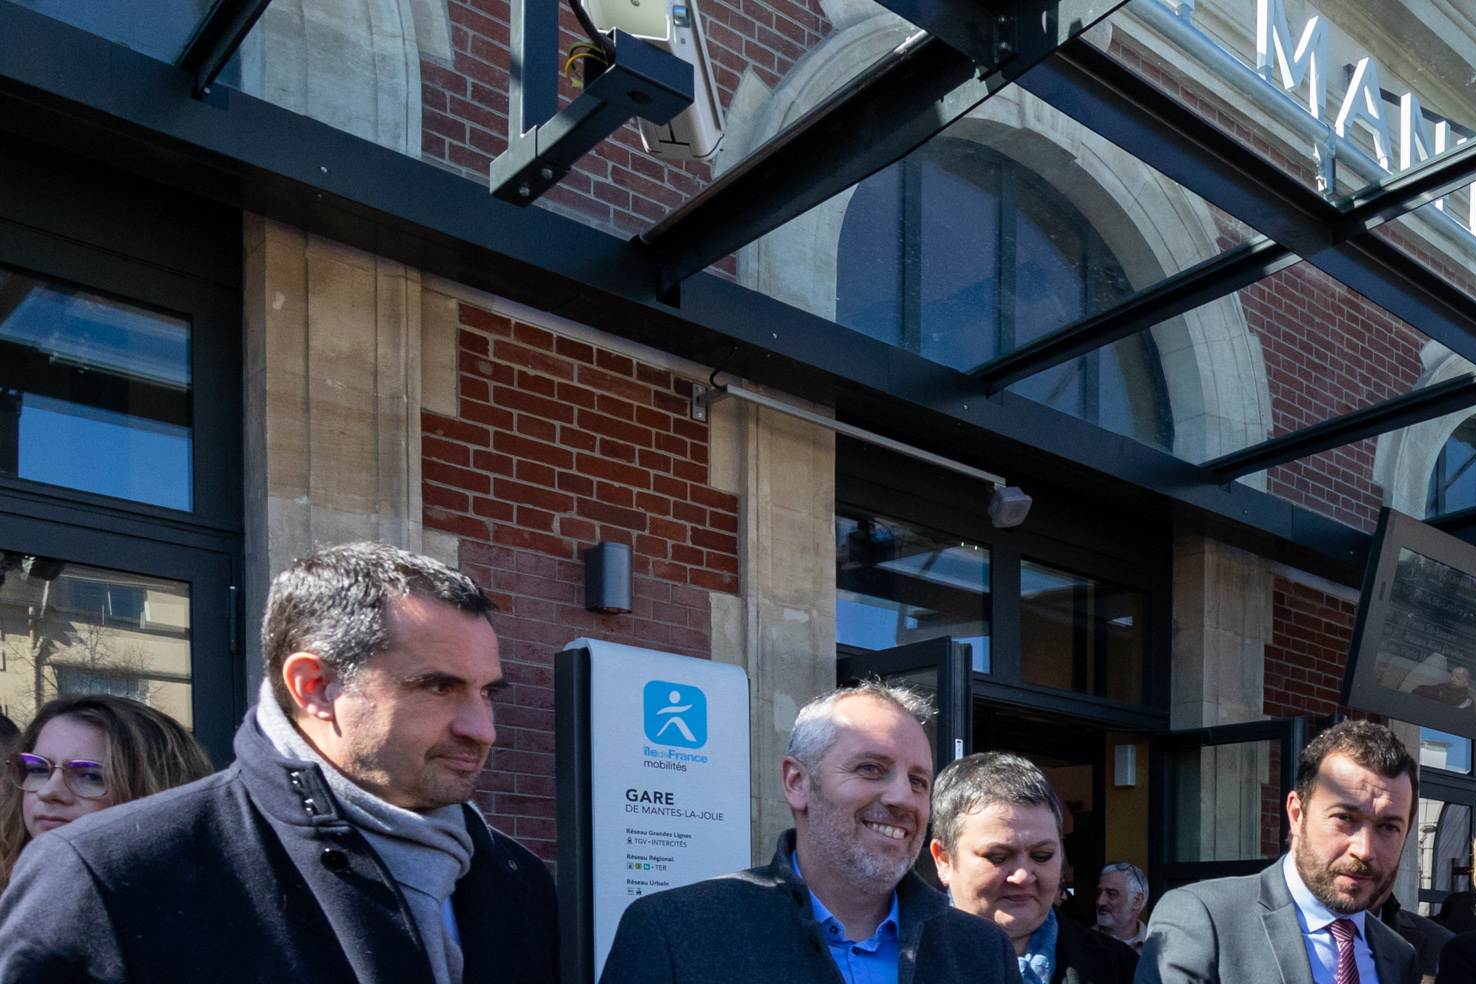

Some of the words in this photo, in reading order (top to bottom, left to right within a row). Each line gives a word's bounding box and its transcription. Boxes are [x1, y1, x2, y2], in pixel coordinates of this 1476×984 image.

[643, 760, 687, 772] mobilités
[625, 788, 675, 806] GARE
[625, 804, 639, 813] DE
[642, 805, 725, 821] MANTES-LA-JOLIE
[648, 829, 673, 838] Grandes
[651, 839, 688, 848] INTERCITÉS
[626, 853, 648, 861] Réseau
[649, 855, 674, 863] Régional
